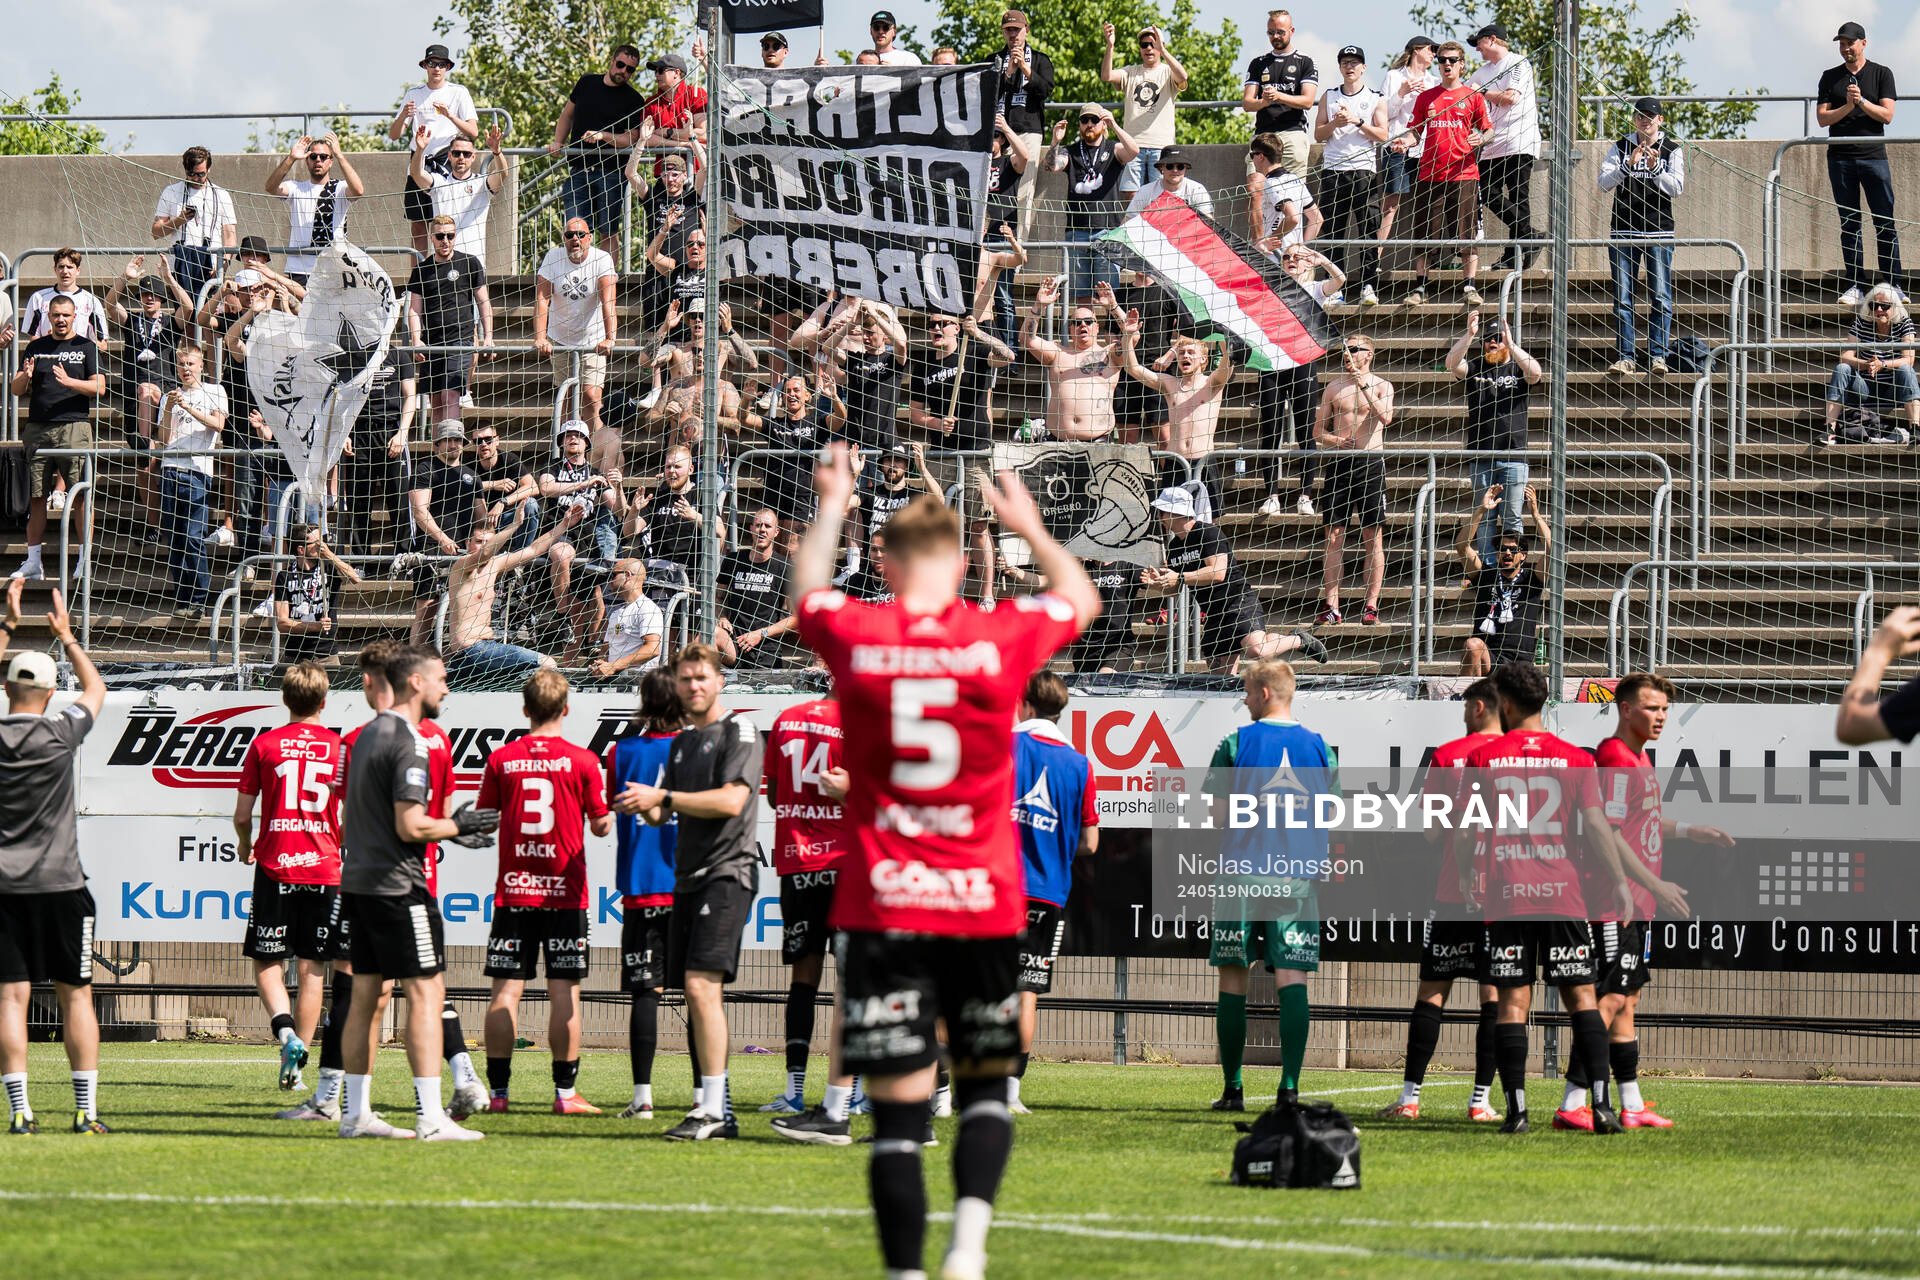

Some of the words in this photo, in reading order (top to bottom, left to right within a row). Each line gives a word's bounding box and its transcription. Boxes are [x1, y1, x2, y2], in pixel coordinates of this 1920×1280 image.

[58, 351, 84, 362] 1908
[890, 678, 962, 790] 5
[1071, 710, 1186, 771] ICA
[780, 738, 831, 797] 14
[1489, 756, 1568, 769] MALMBERGS
[274, 759, 334, 813] 15
[1126, 770, 1186, 792] nära
[521, 777, 555, 835] 3
[1009, 808, 1059, 834] SELECT
[515, 841, 557, 858] KÄCK
[504, 872, 567, 889] GÖRTZ
[489, 938, 522, 951] XACT
[1663, 915, 1747, 958] oday
[1432, 942, 1476, 958] EXACT
[1549, 945, 1591, 961] EXACT
